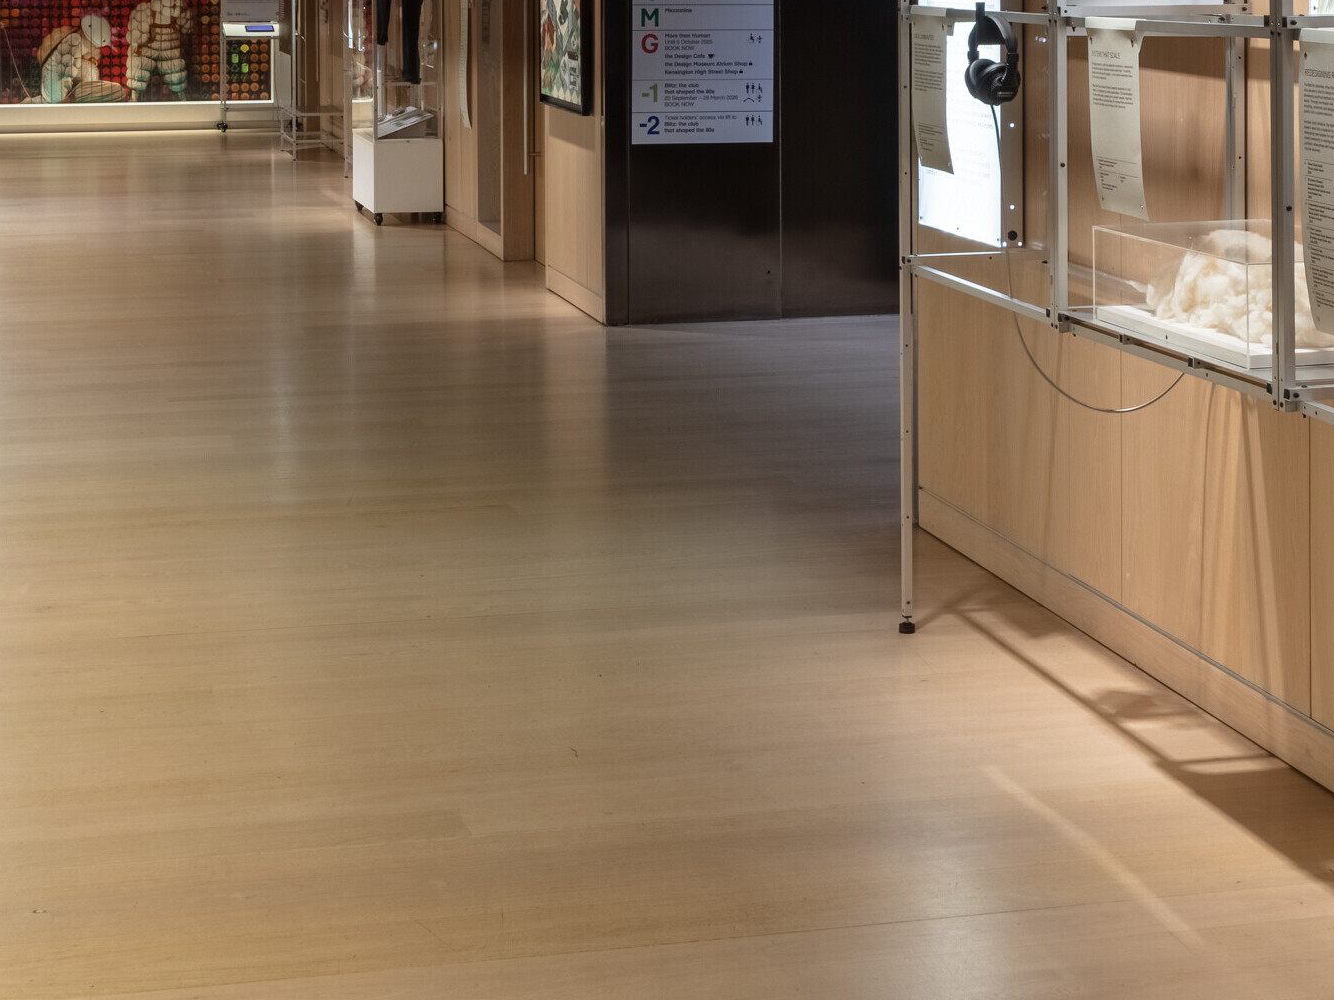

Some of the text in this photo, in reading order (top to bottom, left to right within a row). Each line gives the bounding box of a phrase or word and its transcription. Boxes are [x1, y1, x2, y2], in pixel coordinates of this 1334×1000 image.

[641, 8, 659, 27] M
[641, 33, 658, 54] G
[1304, 69, 1331, 79] REDESIGNING
[641, 83, 658, 102] -1
[639, 115, 660, 135] -2
